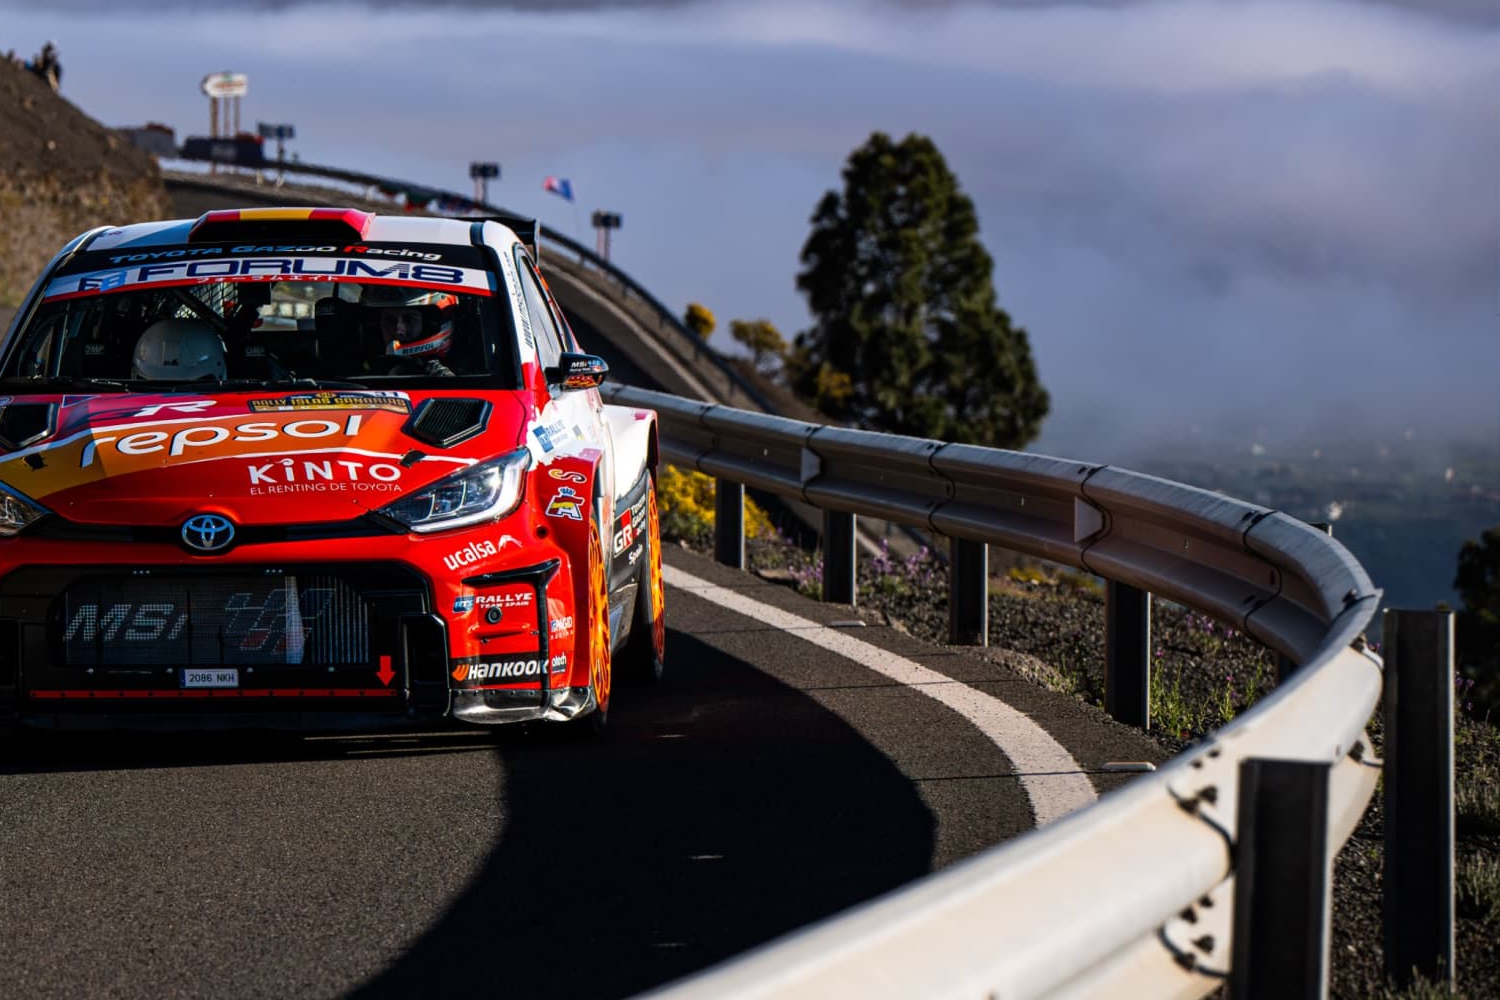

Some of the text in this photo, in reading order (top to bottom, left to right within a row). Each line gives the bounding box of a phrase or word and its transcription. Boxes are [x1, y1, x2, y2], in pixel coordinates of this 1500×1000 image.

[110, 246, 222, 263] TOYOTA
[343, 245, 443, 261] Racing
[138, 259, 464, 284] FORUM8
[80, 415, 363, 468] repsol
[251, 482, 402, 496] EL RENTING DE TOYOTA
[613, 524, 633, 554] GR
[443, 539, 497, 570] ucalsa
[475, 592, 532, 604] RALLYE
[188, 673, 235, 683] 2086 NKH
